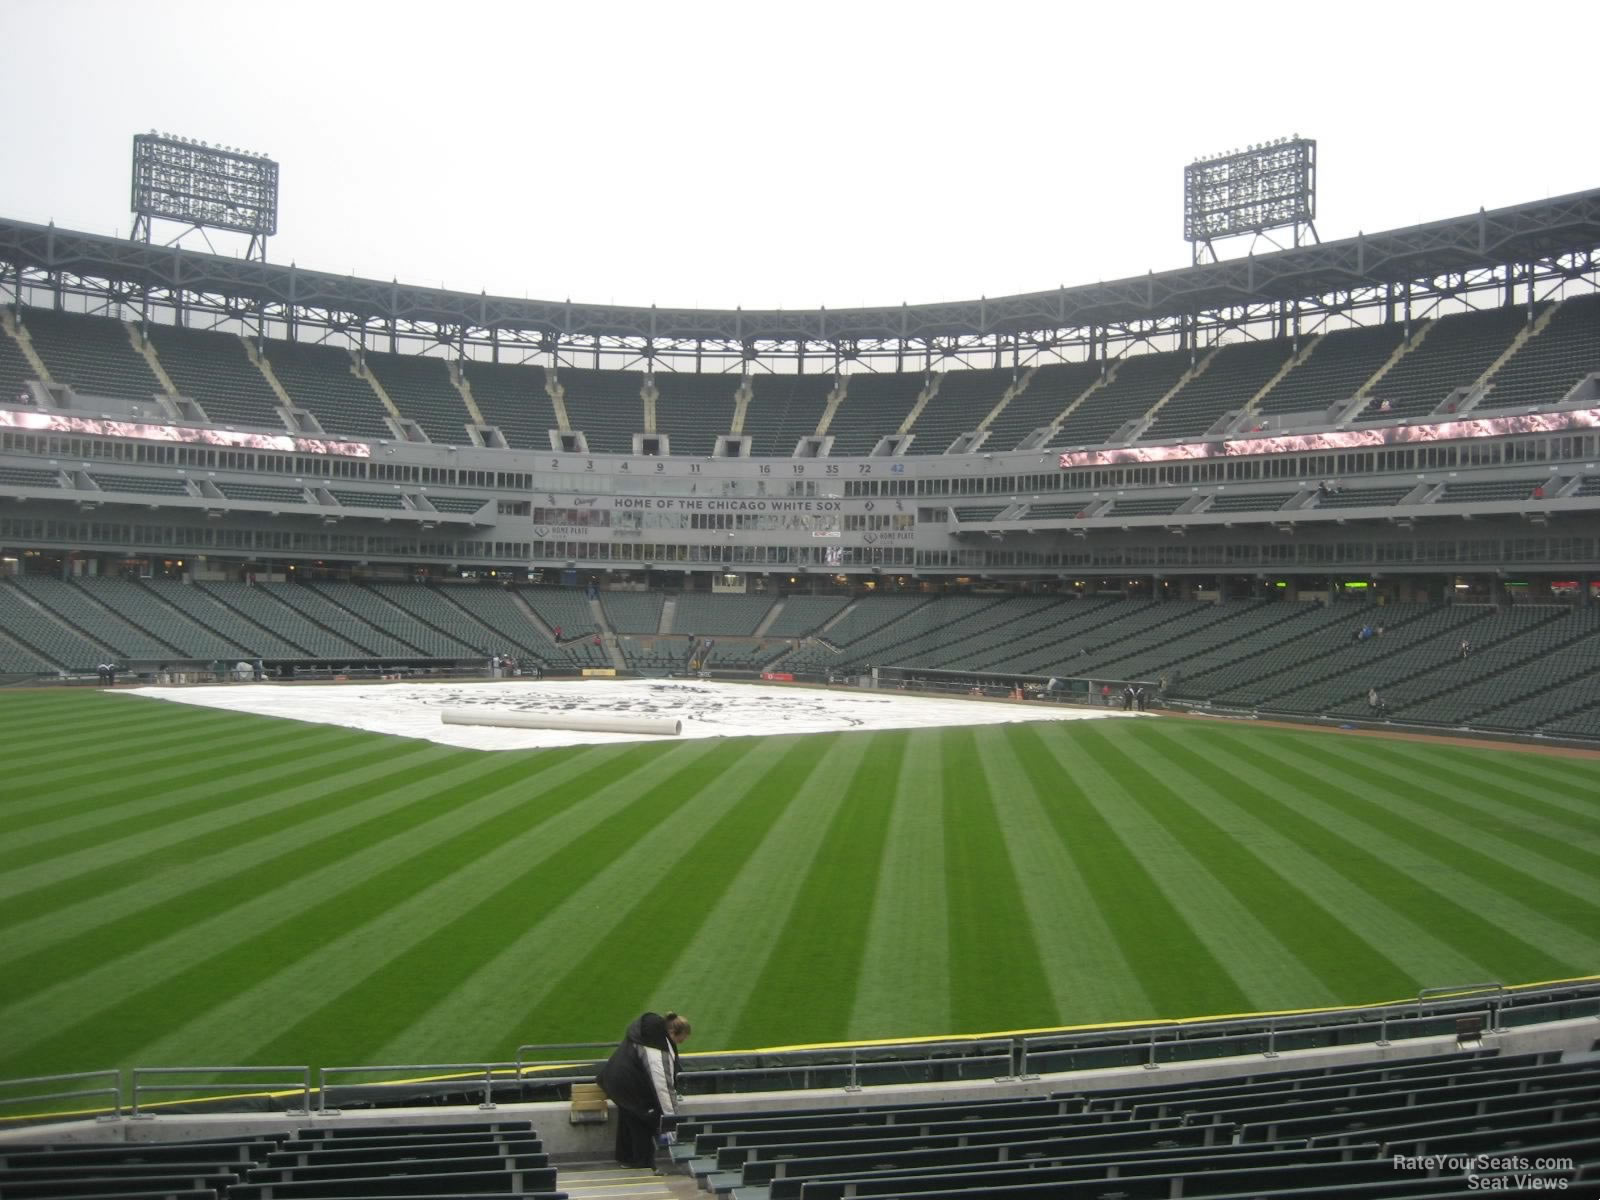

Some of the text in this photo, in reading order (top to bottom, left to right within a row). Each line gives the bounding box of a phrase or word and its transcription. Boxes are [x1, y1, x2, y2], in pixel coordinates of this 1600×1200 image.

[552, 459, 559, 468] 2
[586, 460, 594, 470] 3
[620, 462, 629, 471] 4
[657, 463, 664, 472] 9
[690, 464, 701, 473] 11
[759, 465, 771, 474] 16
[793, 465, 804, 474] 19
[826, 465, 839, 474] 35
[859, 465, 871, 473] 72
[891, 464, 905, 473] 42
[614, 499, 841, 511] HOME OF THE CHICAGO WHITE SOX
[897, 532, 915, 540] PLATE
